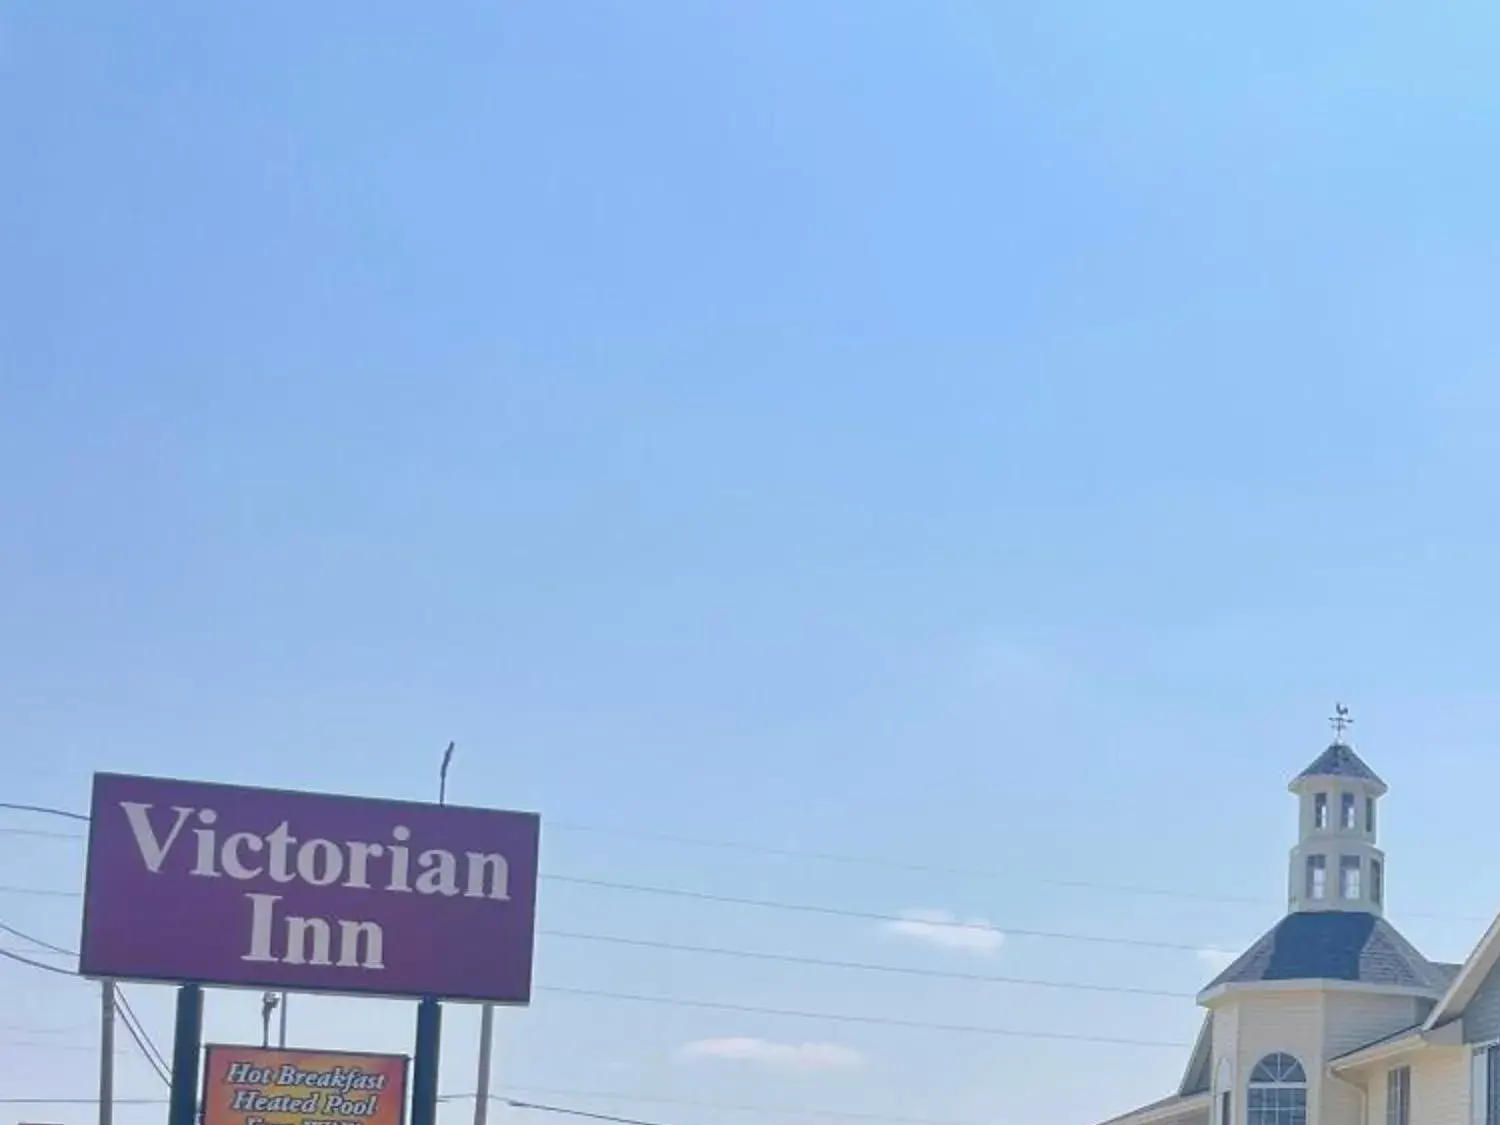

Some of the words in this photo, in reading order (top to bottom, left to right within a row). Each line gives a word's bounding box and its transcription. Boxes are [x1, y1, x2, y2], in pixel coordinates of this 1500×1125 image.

[120, 801, 511, 900] Victorian
[240, 892, 385, 969] Inn
[226, 1062, 269, 1085] Hot
[277, 1065, 387, 1092] Breakfast
[233, 1090, 319, 1114] Heated
[323, 1094, 378, 1116] Pool
